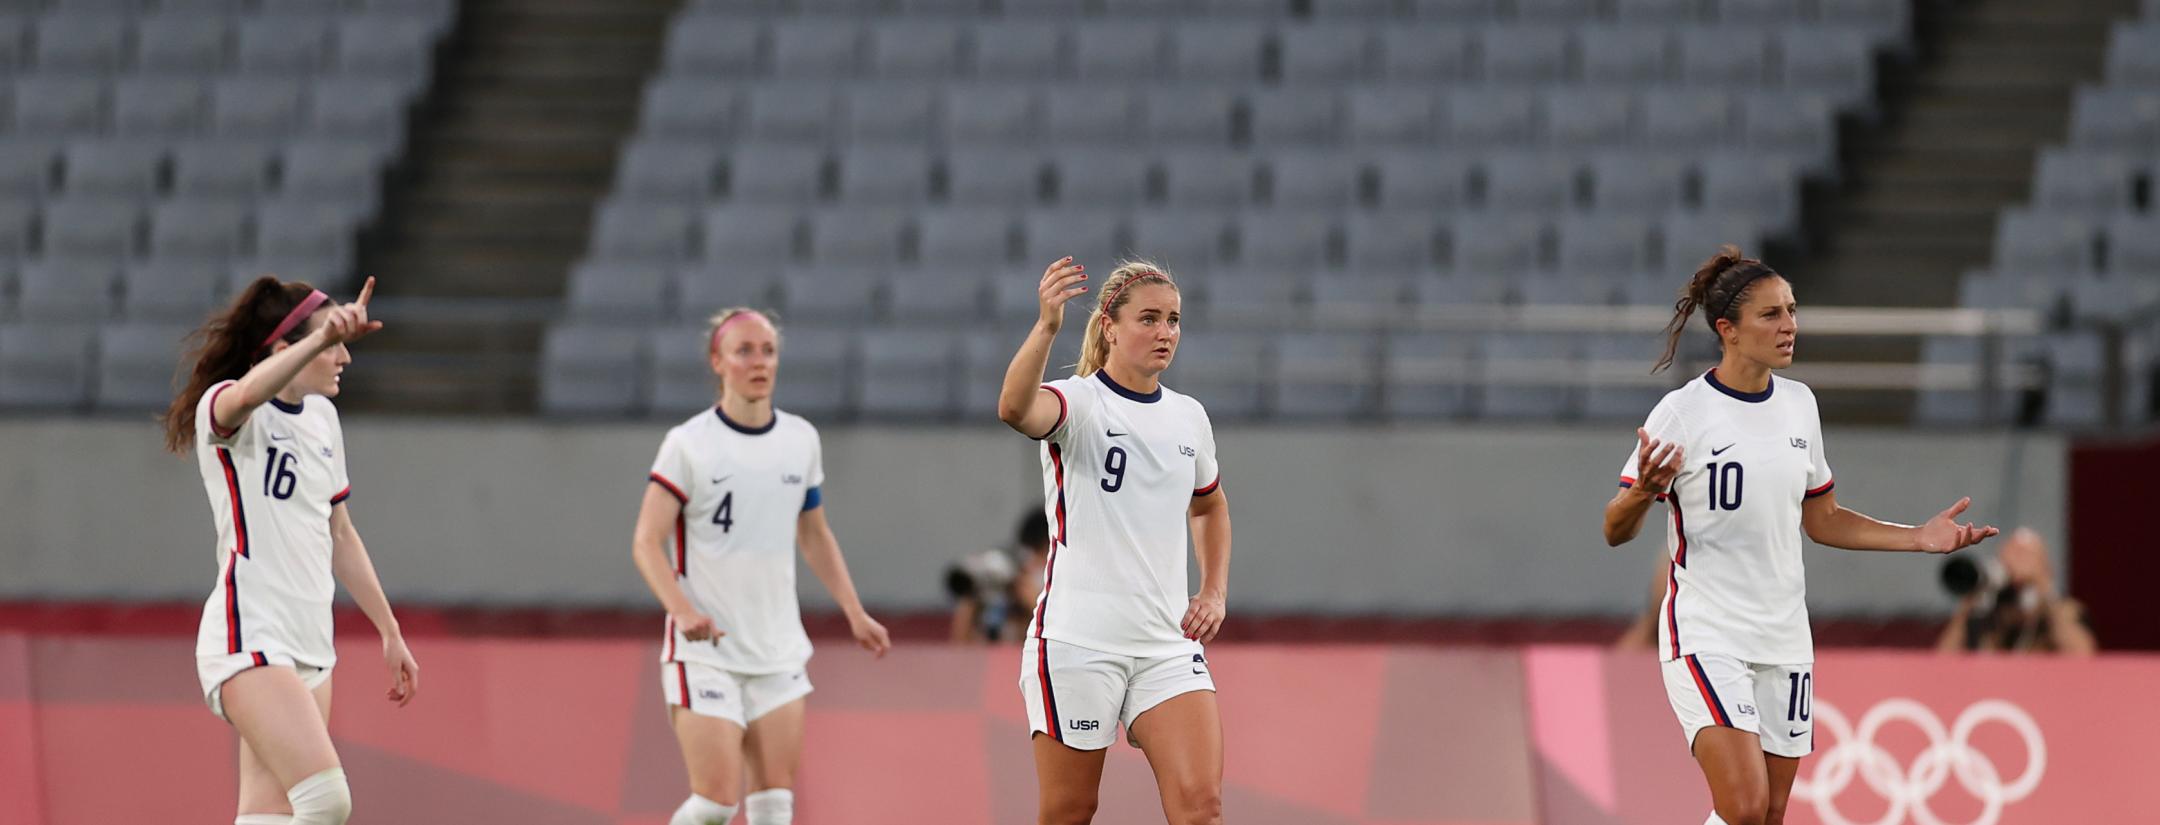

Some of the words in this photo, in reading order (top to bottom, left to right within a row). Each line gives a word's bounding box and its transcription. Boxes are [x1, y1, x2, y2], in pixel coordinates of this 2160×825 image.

[263, 446, 298, 500] 16
[1101, 446, 1127, 493] 9
[1706, 461, 1744, 511] 10
[712, 491, 733, 533] 4
[1787, 672, 1811, 722] 10
[1070, 719, 1099, 730] USA
